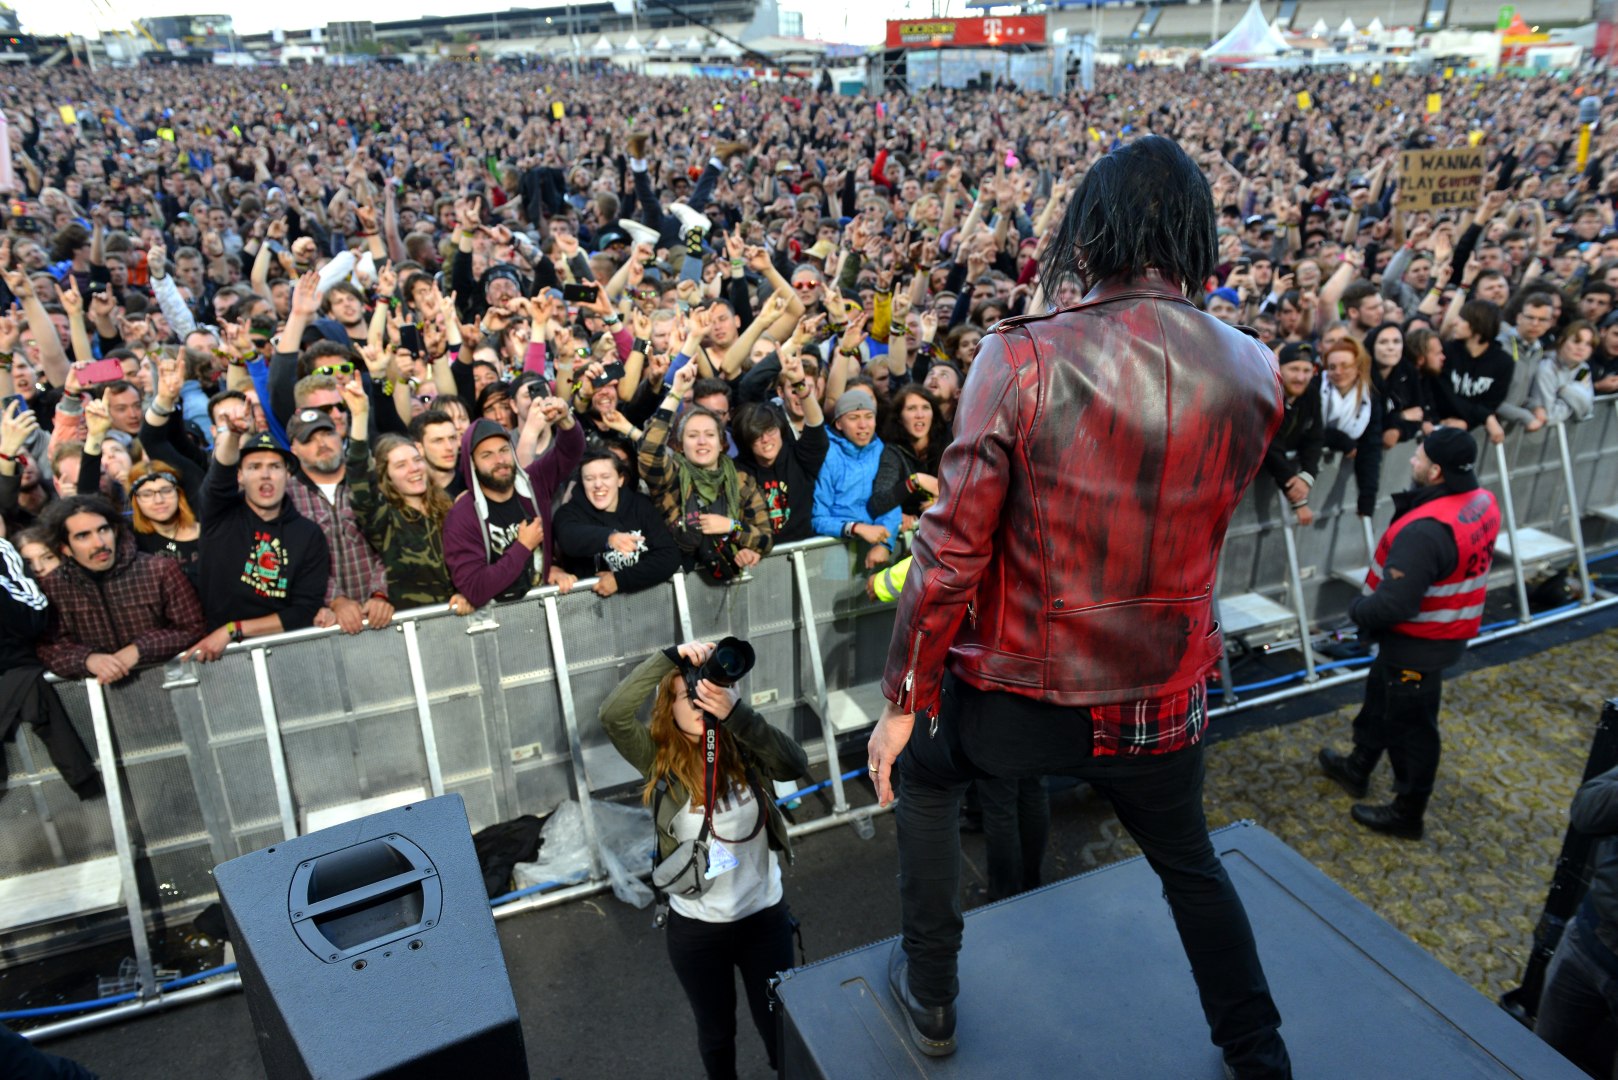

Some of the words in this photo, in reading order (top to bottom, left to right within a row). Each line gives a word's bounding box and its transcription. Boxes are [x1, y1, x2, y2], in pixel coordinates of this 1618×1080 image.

[1404, 155, 1409, 171] I
[1421, 155, 1482, 170] WANNA
[1400, 177, 1434, 190] PLAY
[707, 729, 715, 750] EOS
[707, 751, 715, 763] 6D
